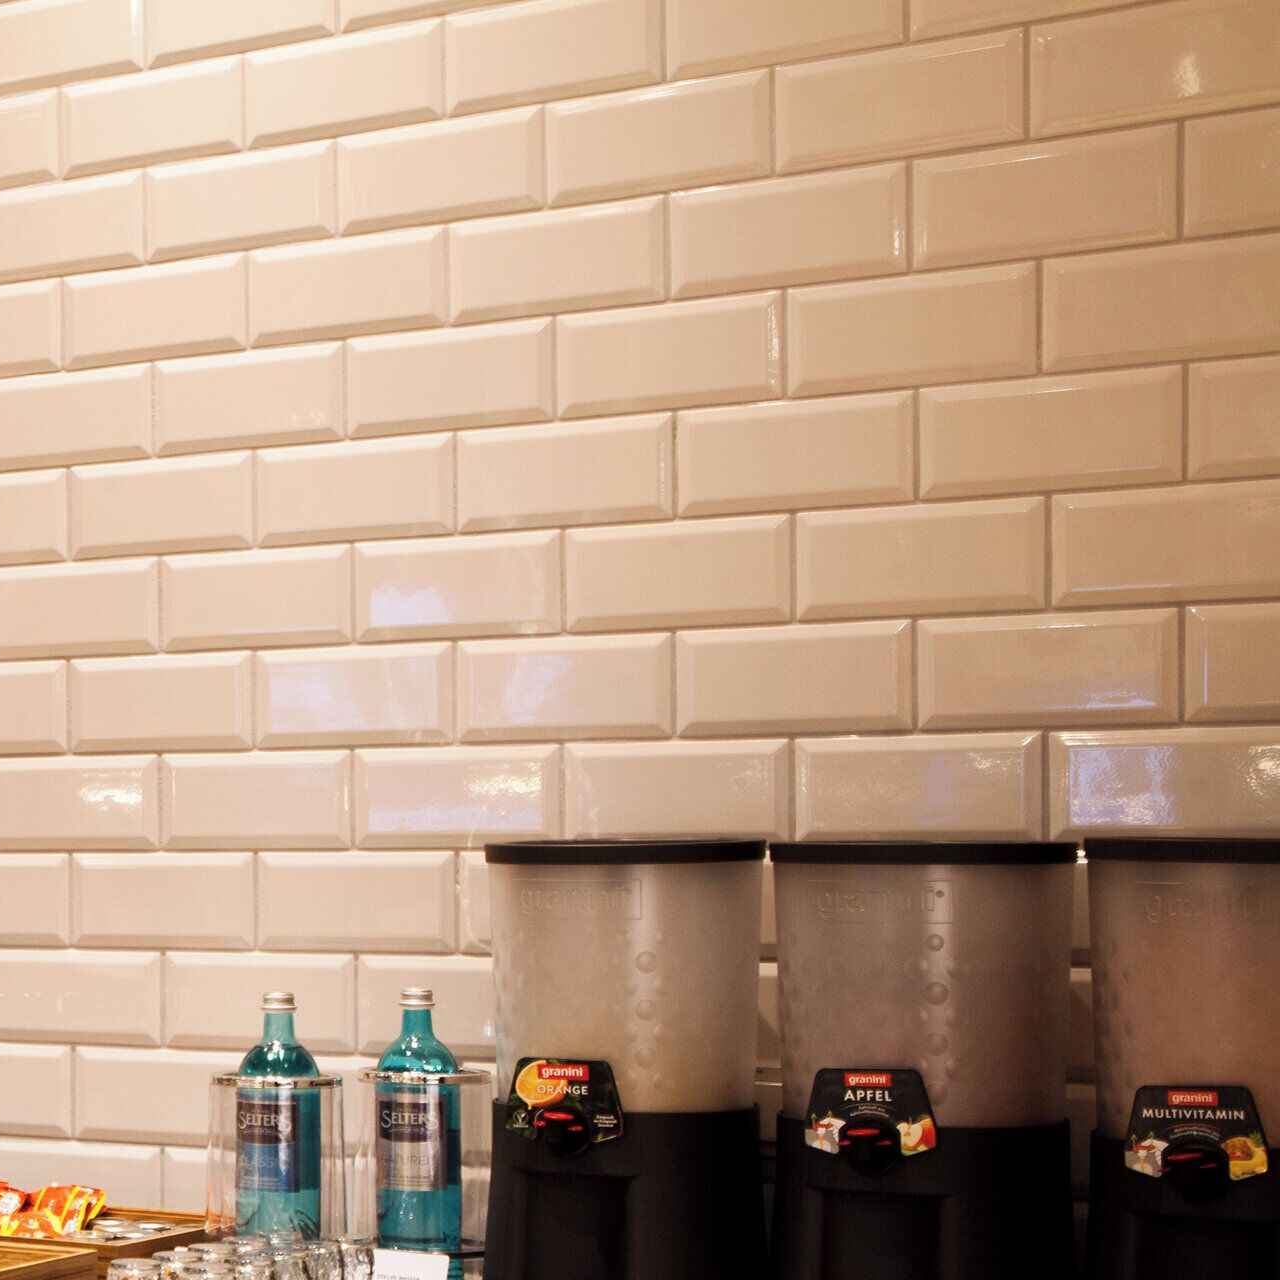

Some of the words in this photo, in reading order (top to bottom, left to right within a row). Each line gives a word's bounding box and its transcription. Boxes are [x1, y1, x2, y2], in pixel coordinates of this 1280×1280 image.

[541, 1066, 583, 1078] granini
[848, 1075, 887, 1085] granini
[536, 1084, 589, 1096] ORANGE
[844, 1089, 893, 1102] APFEL
[1172, 1092, 1213, 1104] granini
[380, 1110, 439, 1129] SELTERS
[1142, 1108, 1245, 1120] MULTIVITAMIN
[237, 1111, 293, 1132] SELTERS
